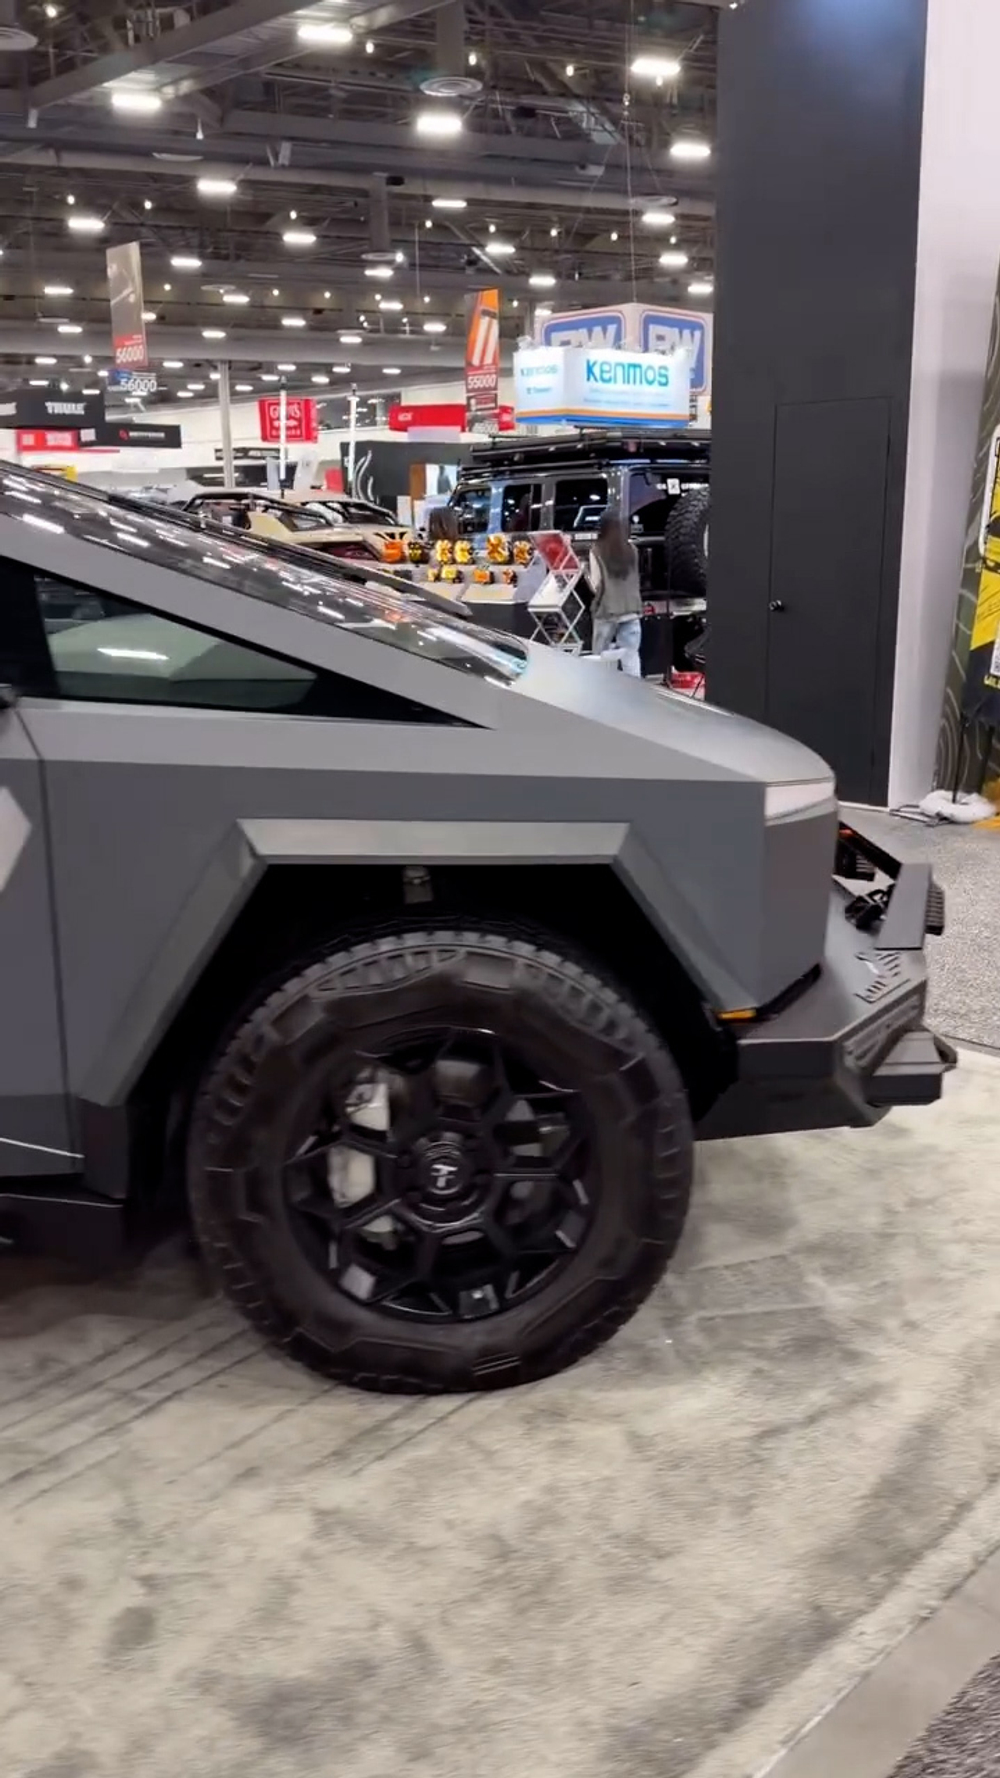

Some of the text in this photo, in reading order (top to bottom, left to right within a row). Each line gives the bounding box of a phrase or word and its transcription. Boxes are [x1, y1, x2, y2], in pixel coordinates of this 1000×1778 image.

[116, 345, 144, 363] 56000
[120, 379, 157, 392] 56000
[468, 374, 497, 390] 55000
